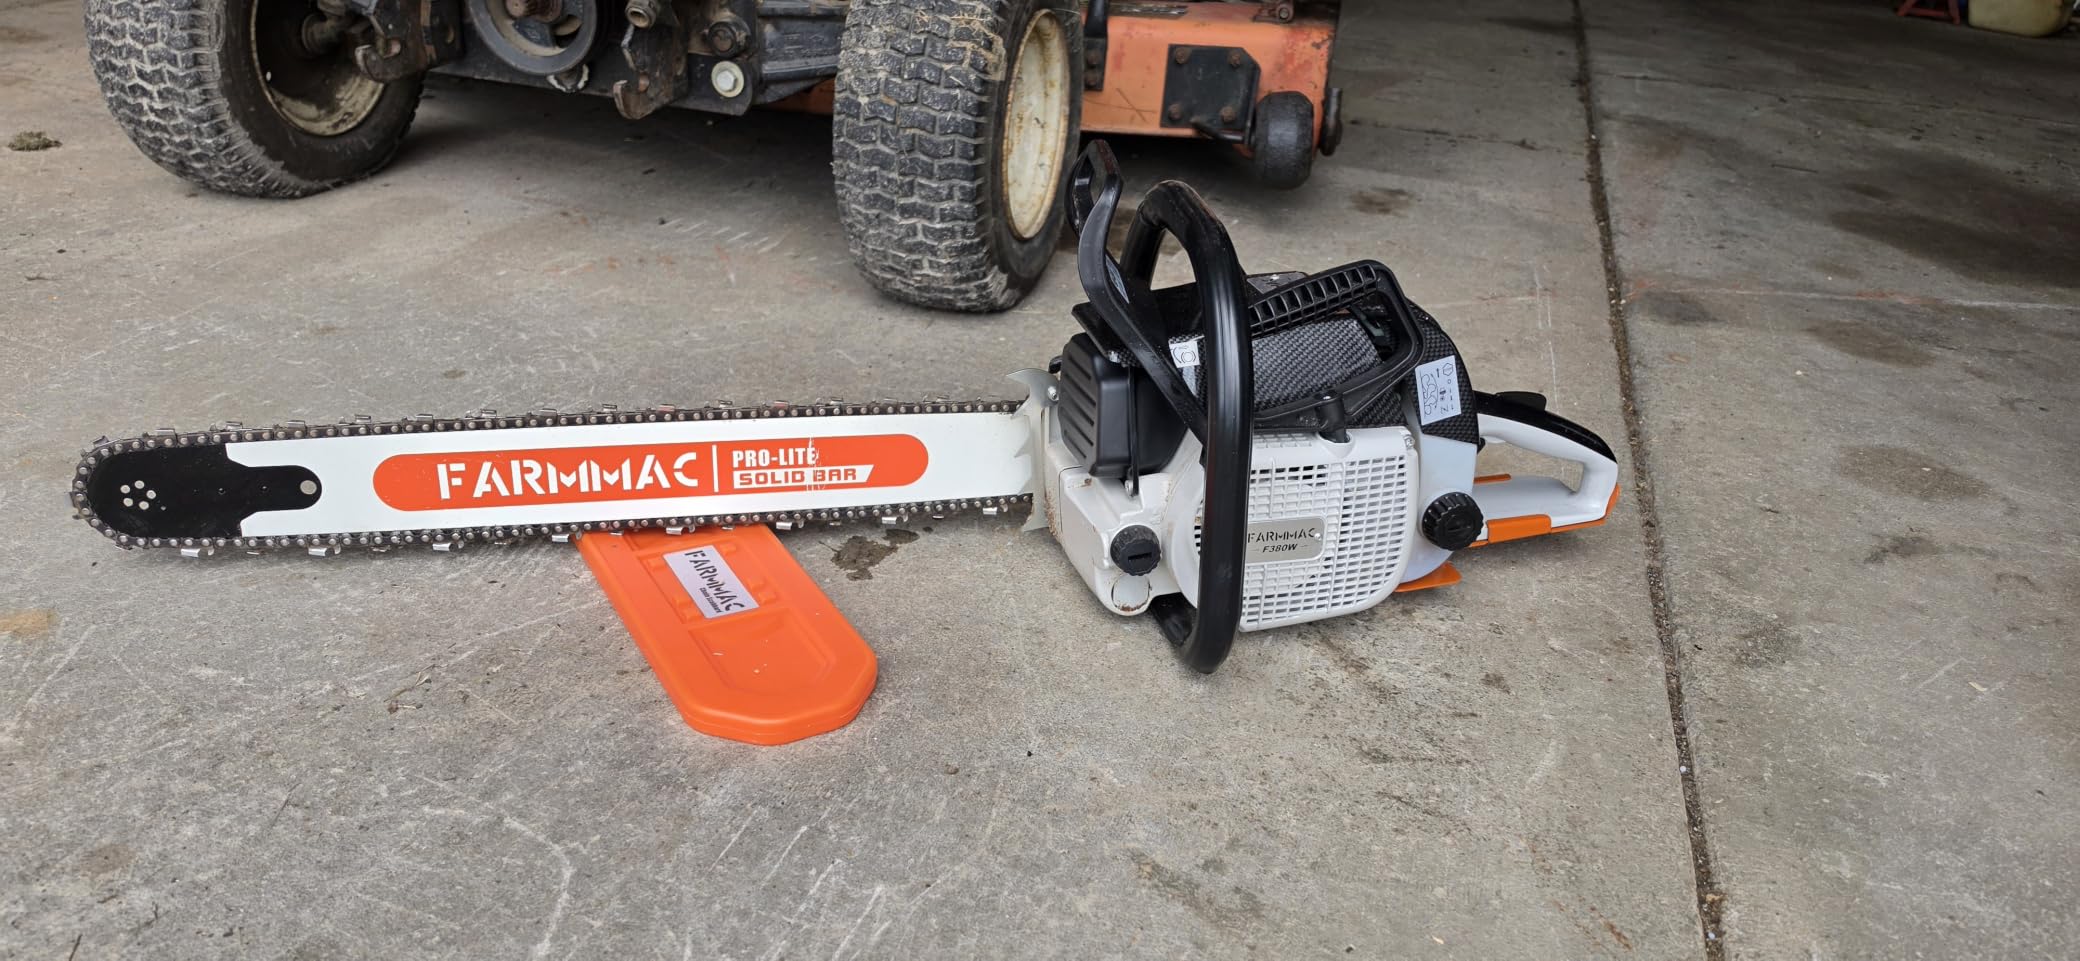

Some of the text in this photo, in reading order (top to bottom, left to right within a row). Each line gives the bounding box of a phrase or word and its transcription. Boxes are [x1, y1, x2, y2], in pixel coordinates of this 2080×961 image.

[732, 447, 816, 468] PRO-LITE
[437, 452, 698, 500] FARMMAC
[740, 468, 857, 486] SOLID BAR
[1248, 528, 1315, 543] FARMMAC
[1262, 543, 1298, 553] F380W
[684, 550, 745, 612] FARMMAC
